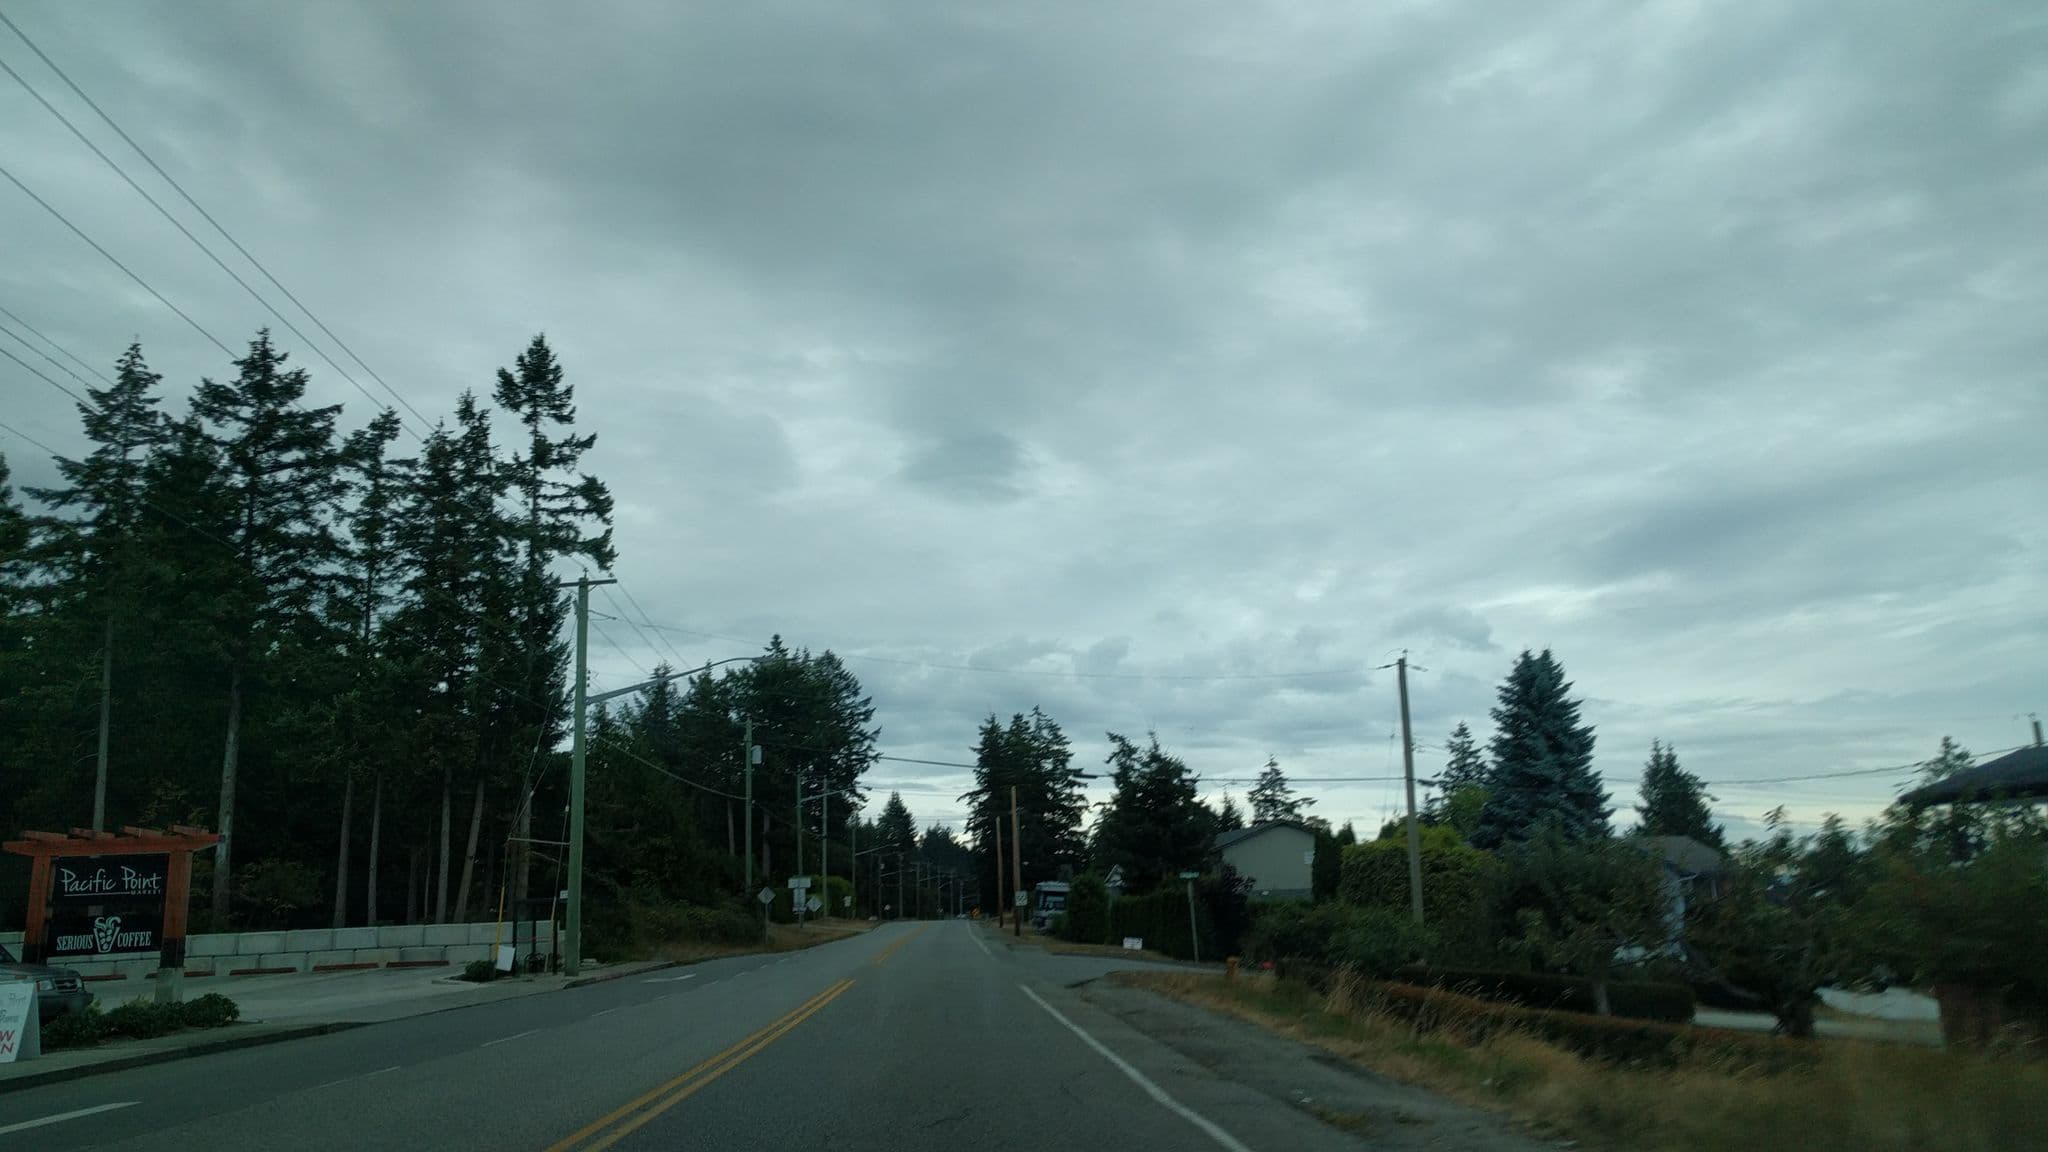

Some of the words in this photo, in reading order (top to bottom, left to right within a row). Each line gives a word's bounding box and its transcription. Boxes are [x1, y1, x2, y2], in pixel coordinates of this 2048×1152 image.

[60, 868, 117, 893] Pacific
[120, 865, 162, 890] Point
[56, 934, 94, 951] SERIOUS
[117, 931, 152, 948] COFFEE
